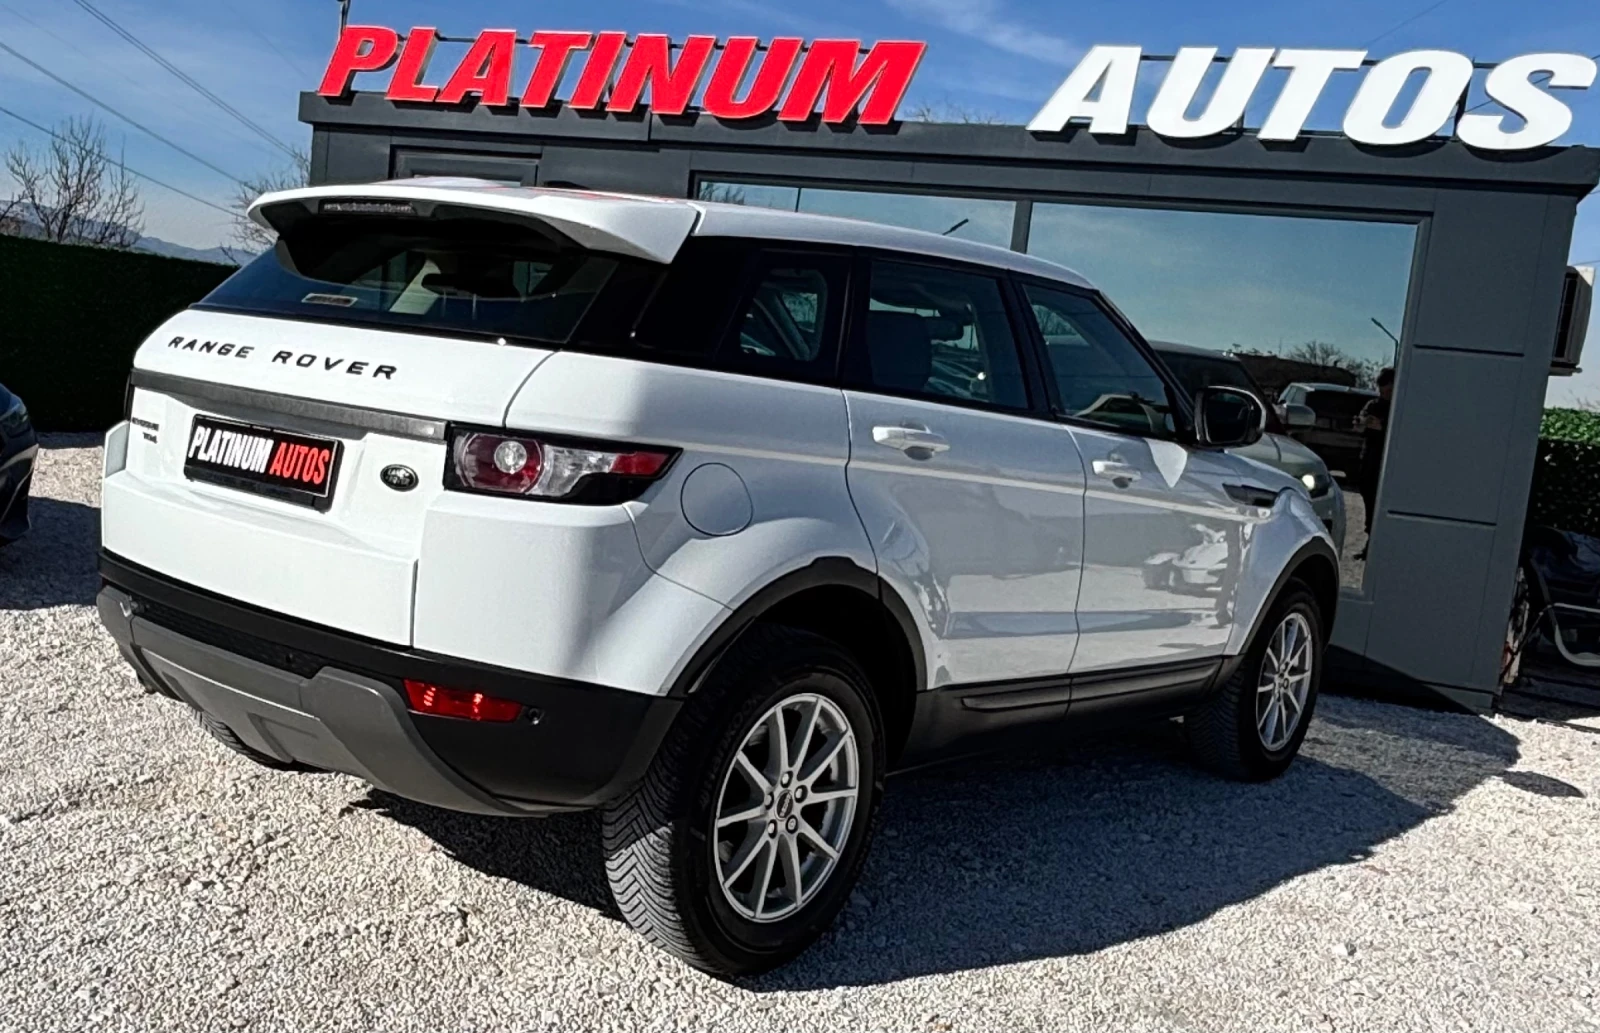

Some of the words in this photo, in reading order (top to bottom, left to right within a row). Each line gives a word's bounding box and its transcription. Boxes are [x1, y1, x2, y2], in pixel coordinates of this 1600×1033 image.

[317, 25, 927, 126] PLATINUM
[1026, 45, 1598, 150] AUTOS
[168, 336, 254, 359] RANGE
[271, 350, 397, 380] ROVER
[188, 425, 274, 473] PLATINUM
[269, 441, 330, 485] AUTOS
